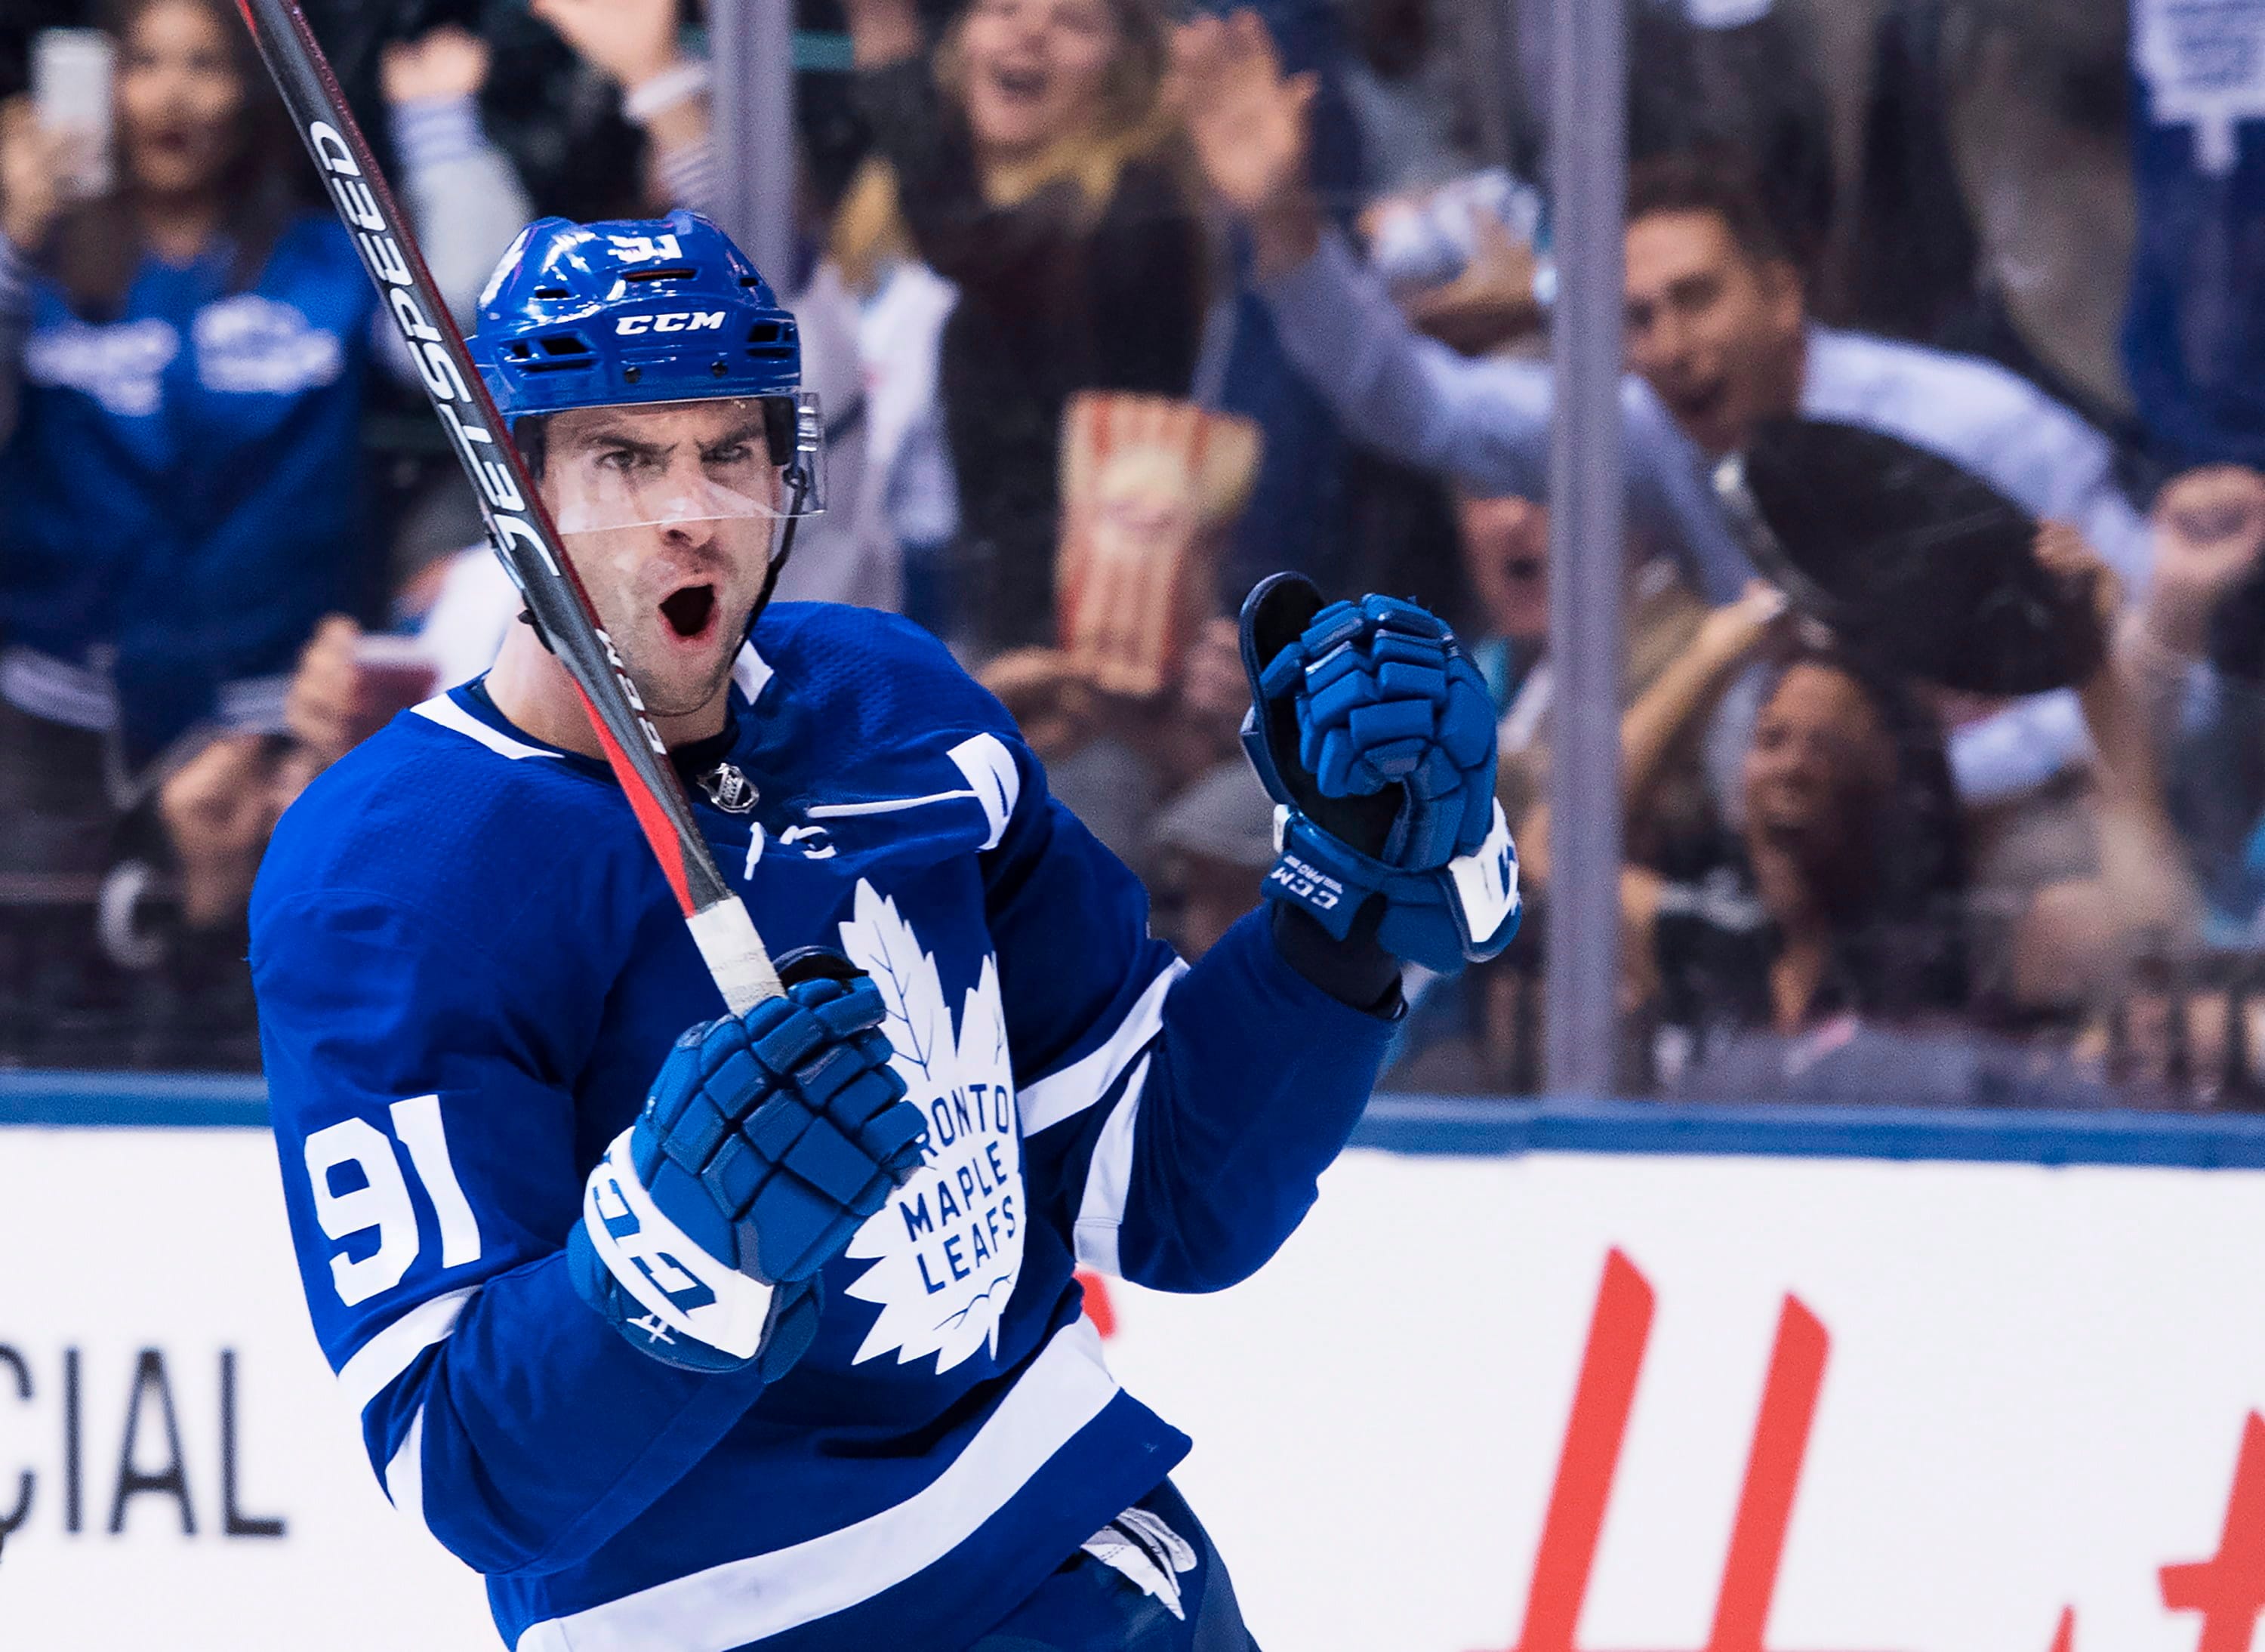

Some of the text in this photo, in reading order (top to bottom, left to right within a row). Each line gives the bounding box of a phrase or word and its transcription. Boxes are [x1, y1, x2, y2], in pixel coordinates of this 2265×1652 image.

[310, 121, 561, 577] JETSPEED
[615, 312, 726, 335] CCM
[1271, 866, 1339, 910] CCM
[911, 1083, 1009, 1157] RONTO
[304, 1094, 482, 1307] 91
[593, 1155, 717, 1321] CC
[898, 1141, 1008, 1242] MAPLE
[917, 1195, 1016, 1295] LEAFS
